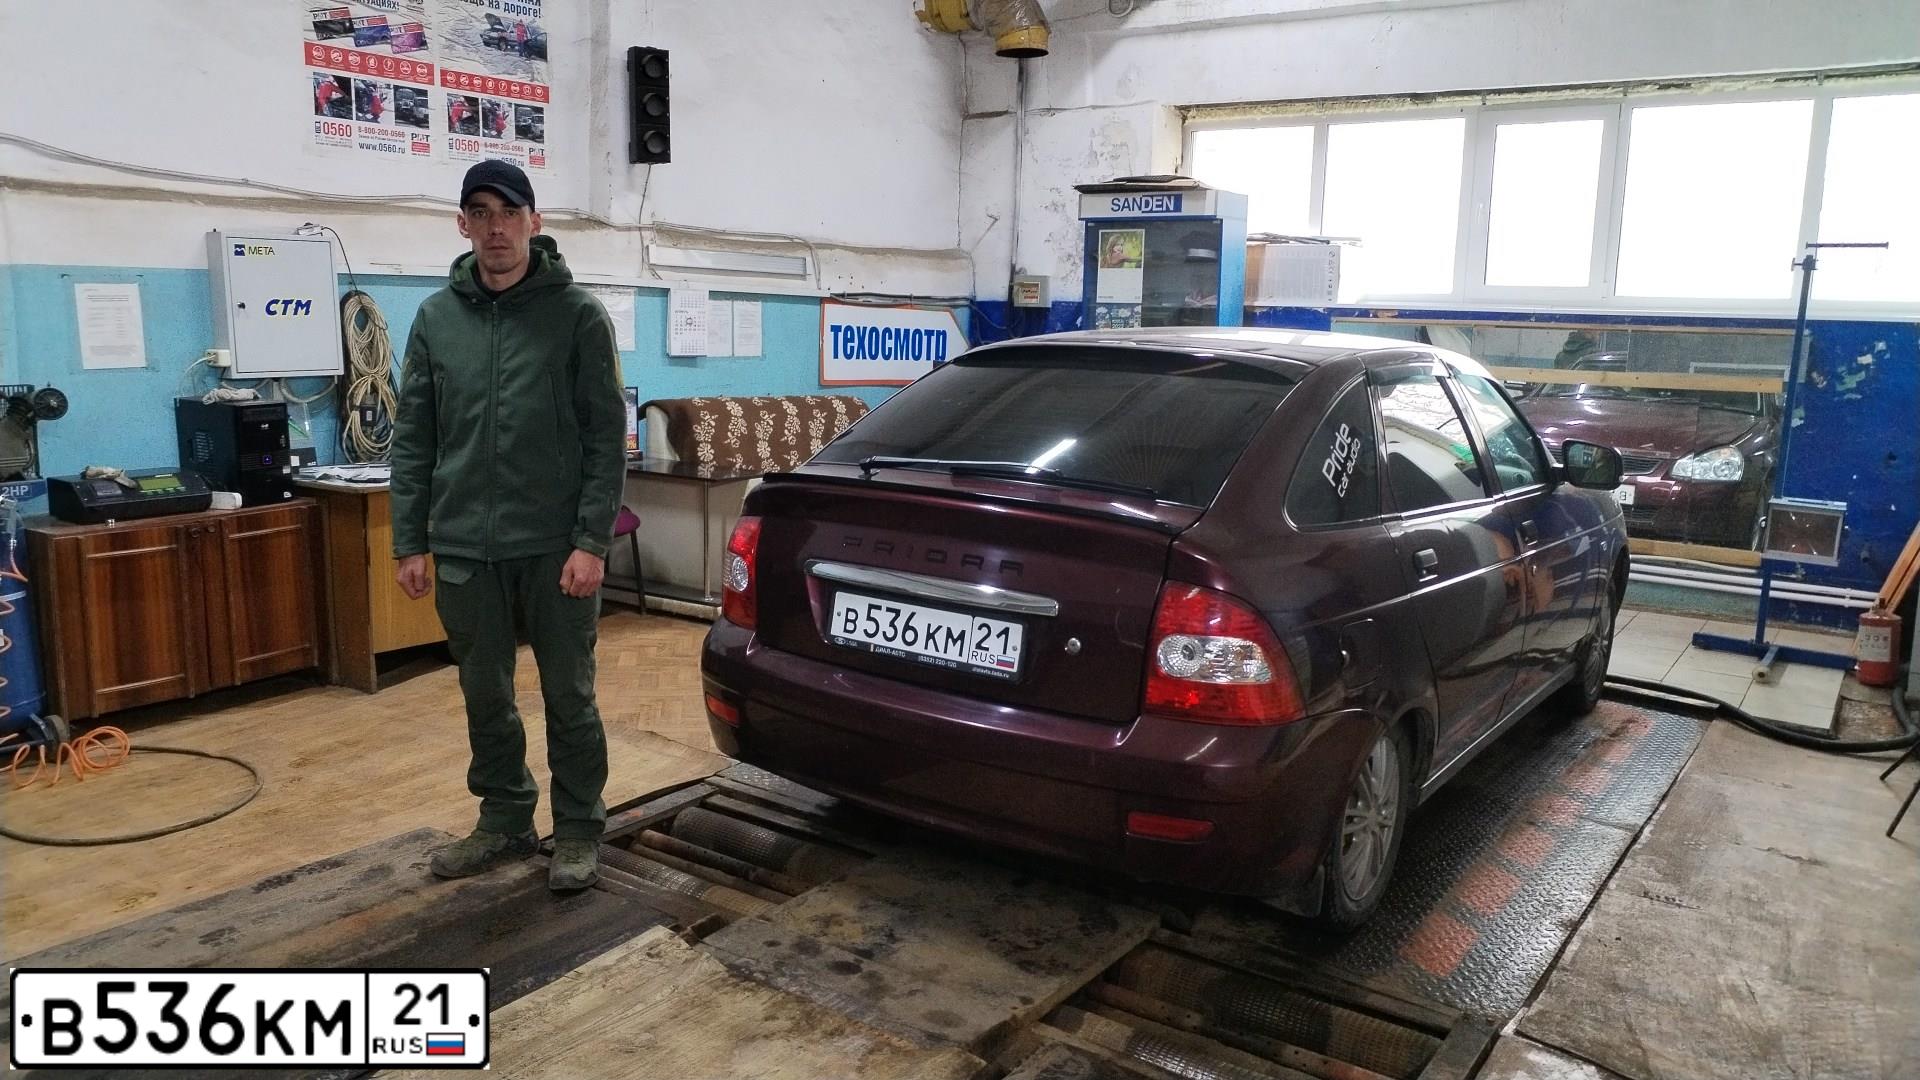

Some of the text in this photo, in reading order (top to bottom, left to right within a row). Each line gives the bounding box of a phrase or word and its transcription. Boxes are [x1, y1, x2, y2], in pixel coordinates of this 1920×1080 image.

[503, 2, 542, 18] дороге!
[323, 121, 352, 137] 0560
[358, 142, 406, 154] www.0560.ru
[455, 138, 480, 152] 0560
[1111, 194, 1175, 212] SANDEN
[1322, 423, 1351, 487] Pride
[1337, 438, 1361, 498] car audio
[2, 486, 29, 497] 2HP
[974, 622, 1010, 655] 21
[970, 650, 996, 665] RUS
